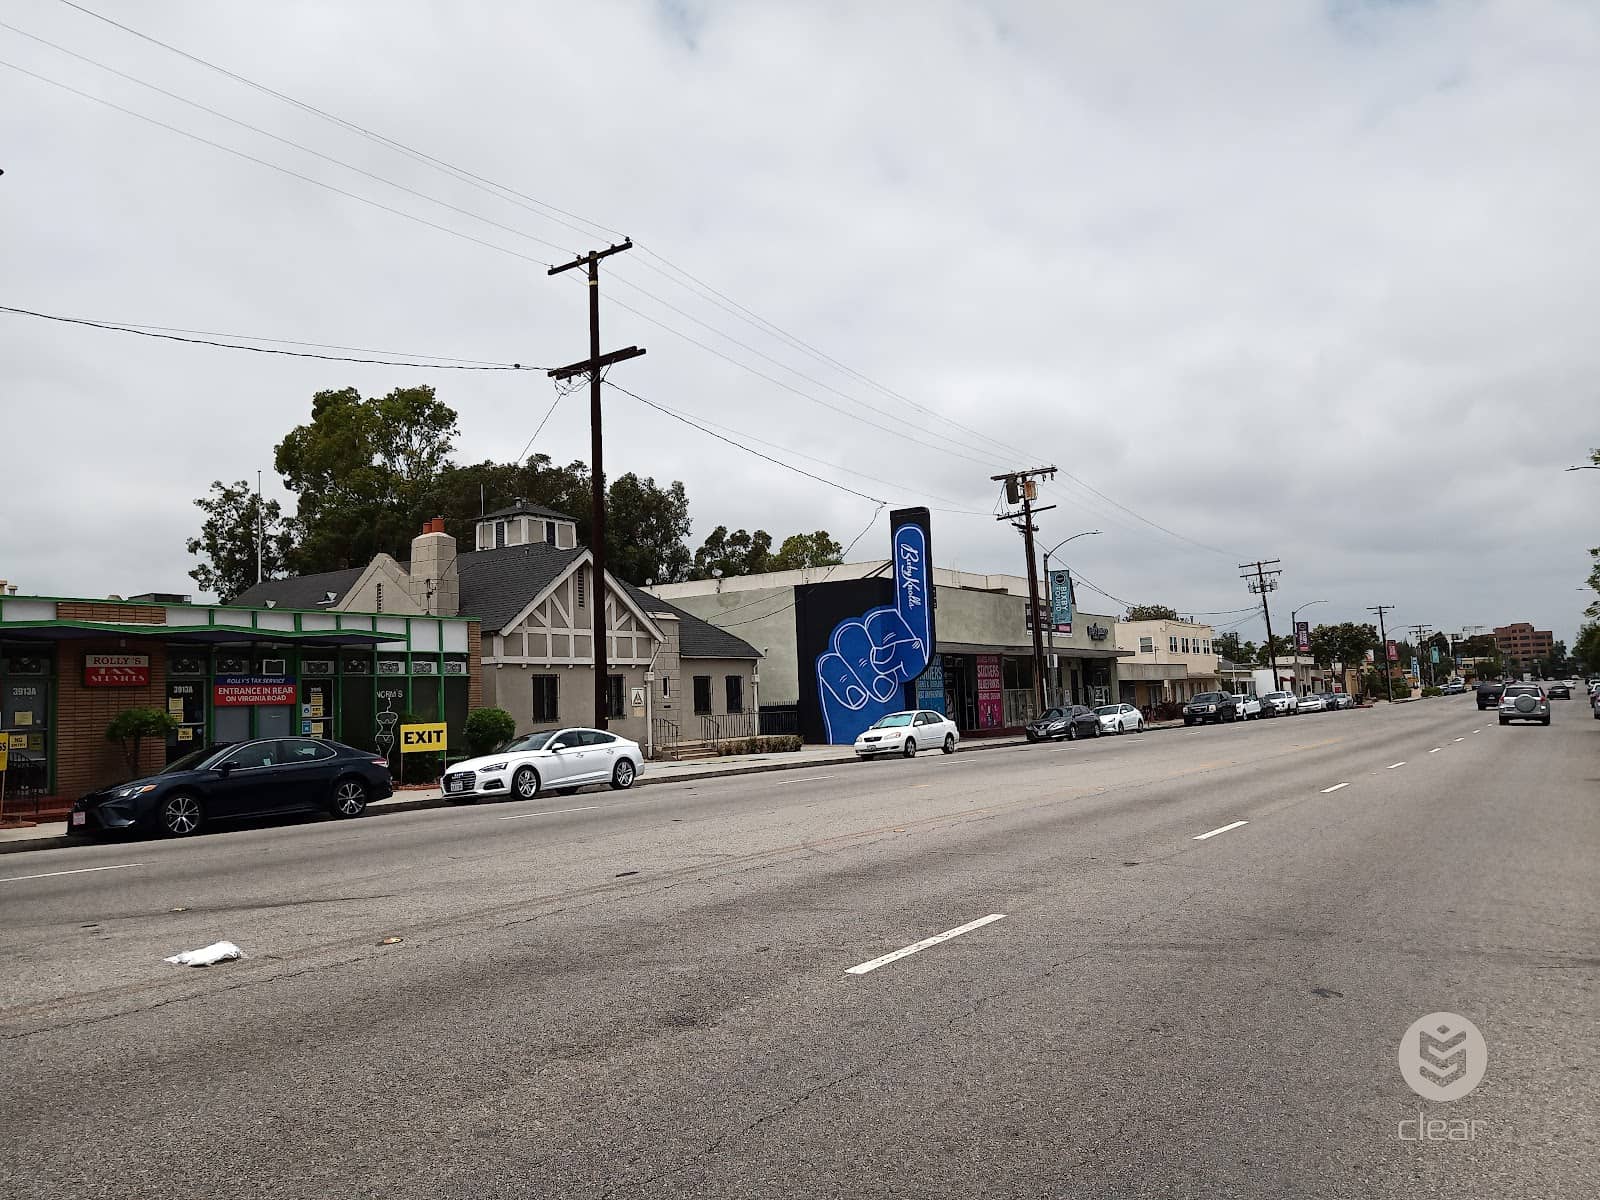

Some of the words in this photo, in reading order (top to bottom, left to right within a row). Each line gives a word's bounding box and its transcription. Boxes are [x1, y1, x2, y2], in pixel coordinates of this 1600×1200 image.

[901, 544, 919, 577] Bixby
[902, 566, 921, 610] Knolls
[1060, 586, 1069, 611] BIXBY
[13, 687, 37, 696] 3913A
[218, 687, 261, 695] ENTRANCE
[272, 686, 294, 694] REAR
[404, 730, 444, 745] EXIT
